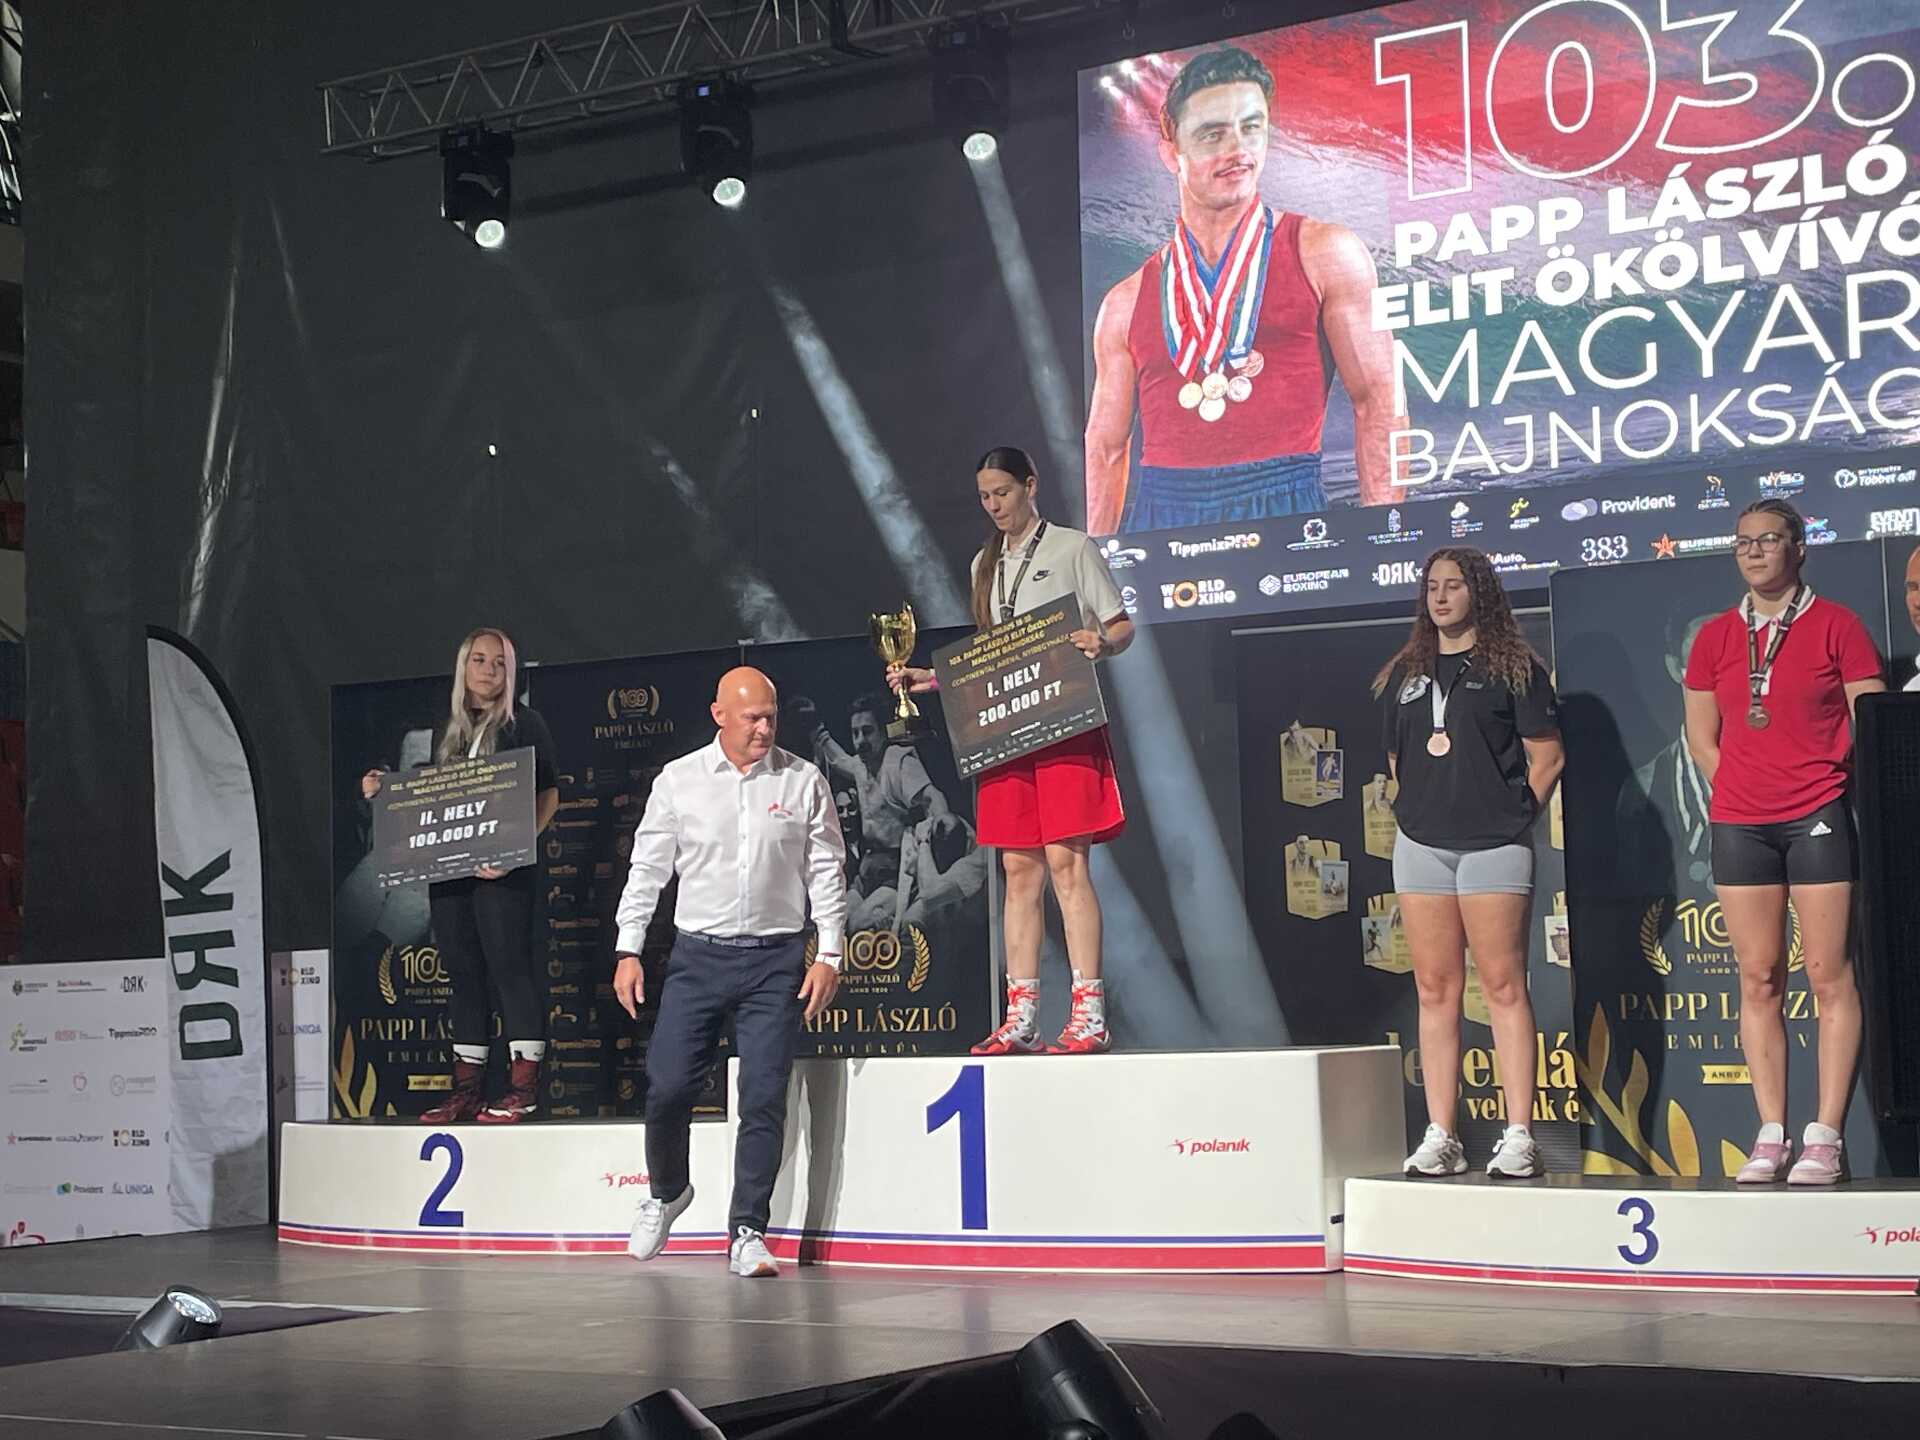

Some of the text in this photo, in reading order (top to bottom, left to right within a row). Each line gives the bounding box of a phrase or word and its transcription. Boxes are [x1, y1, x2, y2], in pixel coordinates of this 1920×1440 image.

[1394, 128, 1907, 268] PAPP LÁSZLÓ
[1370, 187, 1920, 332] ELIT ÖKÖLVÍVÓ
[1392, 268, 1920, 417] MAGYAR
[1602, 494, 1676, 515] Provident
[1870, 508, 1914, 521] EVENT
[1870, 519, 1913, 533] STUFF
[1168, 533, 1260, 557] TippmixPRO
[1581, 535, 1629, 562] 383
[1283, 568, 1349, 584] EUROPEAN
[1283, 580, 1329, 593] BOXING
[1003, 662, 1041, 692] HELY
[978, 680, 1062, 727] 200.000 FT
[420, 800, 487, 826] II. HELY
[409, 820, 498, 848] 100.000 FT
[1686, 953, 1721, 964] PAPP
[857, 1002, 957, 1033] LÁSZLÓ
[1620, 991, 1708, 1020] PAPP
[361, 1017, 414, 1041] PAPP
[926, 1065, 988, 1230] 1
[1190, 1138, 1250, 1156] polanik
[125, 1184, 154, 1196] UNIQA
[419, 1132, 464, 1227] 2
[1617, 1197, 1659, 1265] 3
